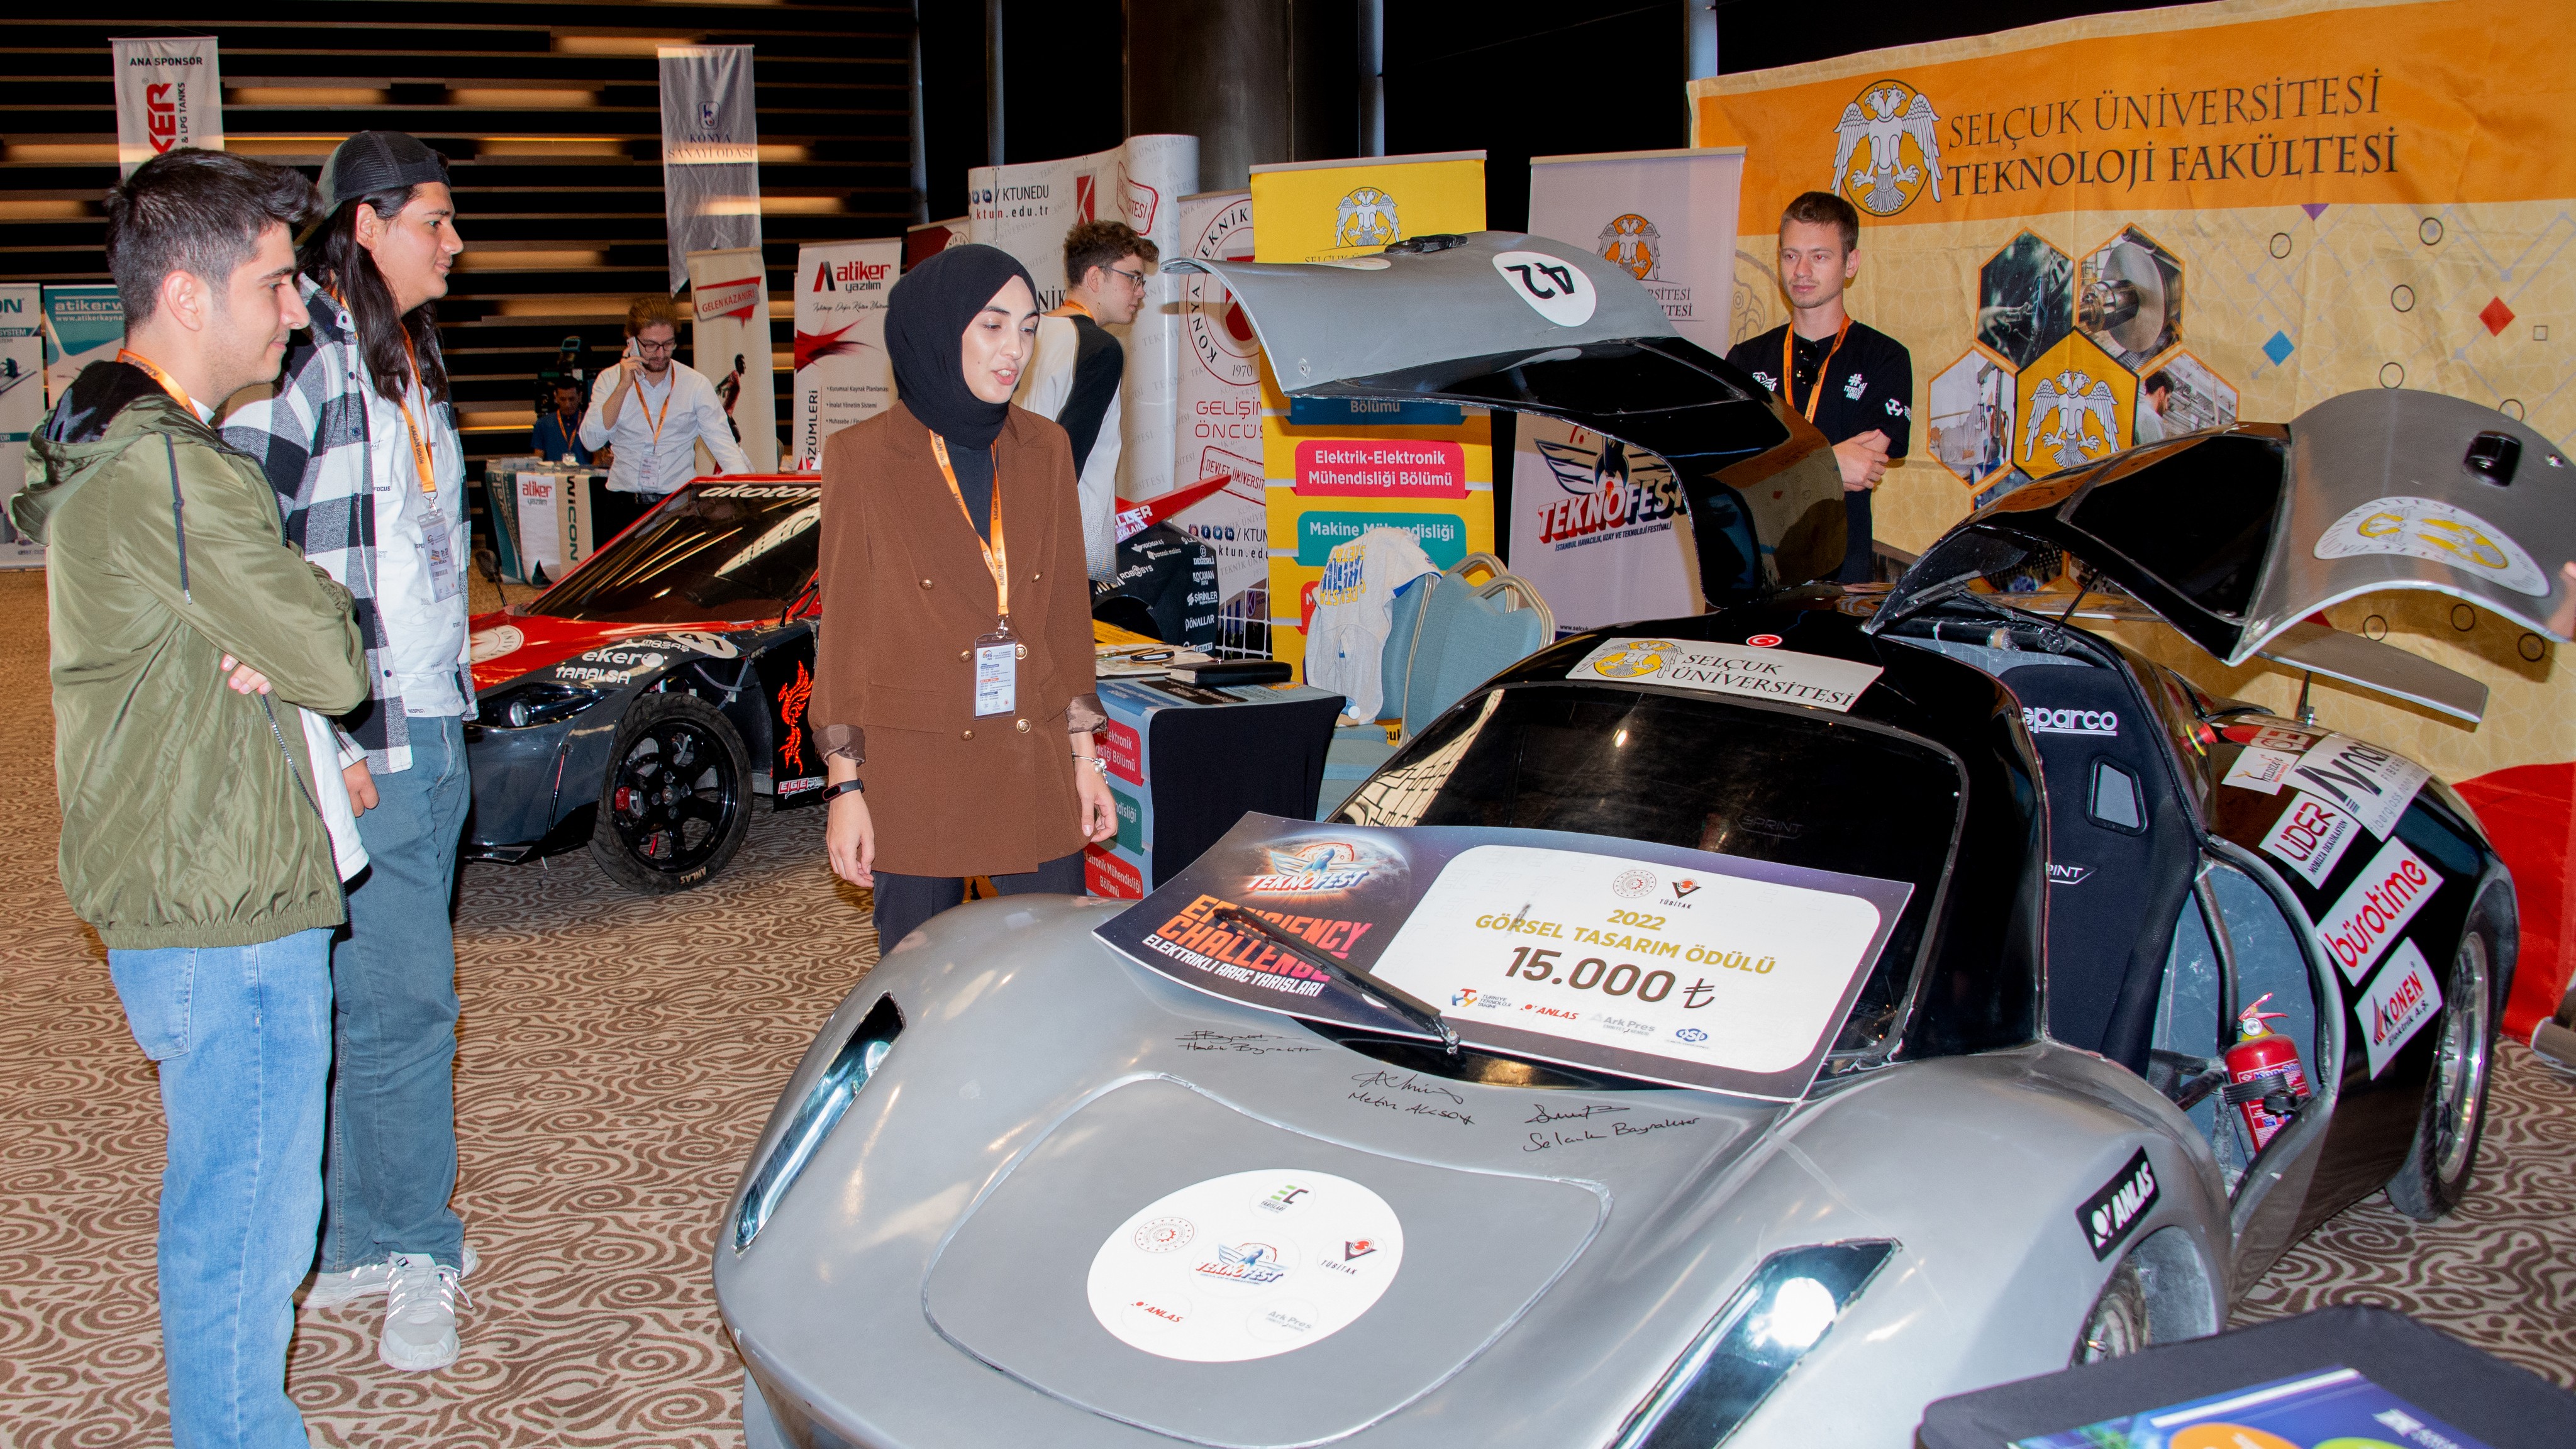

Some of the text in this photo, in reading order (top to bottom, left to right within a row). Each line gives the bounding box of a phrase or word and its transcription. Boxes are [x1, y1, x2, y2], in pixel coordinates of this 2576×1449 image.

[130, 56, 203, 66] ANA SPONSOR
[177, 82, 187, 113] TANKS
[1948, 68, 2384, 151] SELÇUK ÜNİVERSİTESİ
[179, 116, 189, 134] LPG
[690, 133, 731, 143] KONYA
[668, 146, 753, 158] SANAYİ ODASI
[1946, 126, 2399, 198] TEKNOLOJİ FAKÜLTESİ
[1002, 185, 1049, 202] KTUNEDU
[836, 260, 891, 281] atiker
[845, 280, 881, 294] yazılım
[1504, 262, 1575, 300] 42
[0, 298, 23, 313] N
[702, 299, 723, 313] GELEN
[1191, 285, 1218, 364] KONYA
[1232, 364, 1253, 378] 1970
[1351, 400, 1400, 413] Bölümü
[1206, 458, 1230, 475] DEVLET
[1315, 450, 1445, 465] Elektrik-Elektronik
[522, 480, 553, 498] atiker
[1309, 471, 1452, 487] Mühendisliği Bölümü
[1538, 476, 1689, 544] TEKNOFEST
[1309, 522, 1359, 536] Makine
[1555, 540, 1577, 552] İSTANBUL
[1602, 533, 1614, 541] UZAY
[1622, 527, 1647, 538] TEKNOLOJİ
[1647, 521, 1672, 533] FESTİVALİ
[1193, 556, 1215, 565] DEĞERLİ
[1194, 591, 1218, 602] ŞİRİNLER
[679, 632, 724, 652] 41
[1684, 654, 1784, 676] SELÇUK
[555, 666, 632, 685] TARALSA
[1671, 668, 1856, 706] ÜNİVERSİTESİ
[1113, 750, 1135, 772] Bölümü
[2308, 818, 2348, 875] MOBİLYA DEKORASYON
[1099, 875, 1119, 897] Bölümü
[1107, 862, 1141, 894] Mühendisliği
[1246, 869, 1371, 892] TEKNOFEST
[1659, 899, 1692, 909] TÜBİTAK
[2323, 858, 2428, 969] bürotime
[1606, 909, 1667, 931] 2022
[1475, 913, 1777, 975] GÖRSEL TASARIM ÖDÜLÜ
[1141, 933, 1327, 998] ELEKTRİKLİ ARAÇ YARIŞLARI
[1505, 947, 1677, 1002] 15.000
[1536, 1007, 1579, 1020] ANLAS
[1603, 1016, 1656, 1032] Ark Pres
[2111, 1161, 2155, 1230] ANLAS
[1195, 1260, 1284, 1284] TEKNOFEST
[1321, 1260, 1358, 1275] TÜBİTAK
[1144, 1306, 1185, 1323] ANLAS
[1267, 1310, 1313, 1331] Ark Pres
